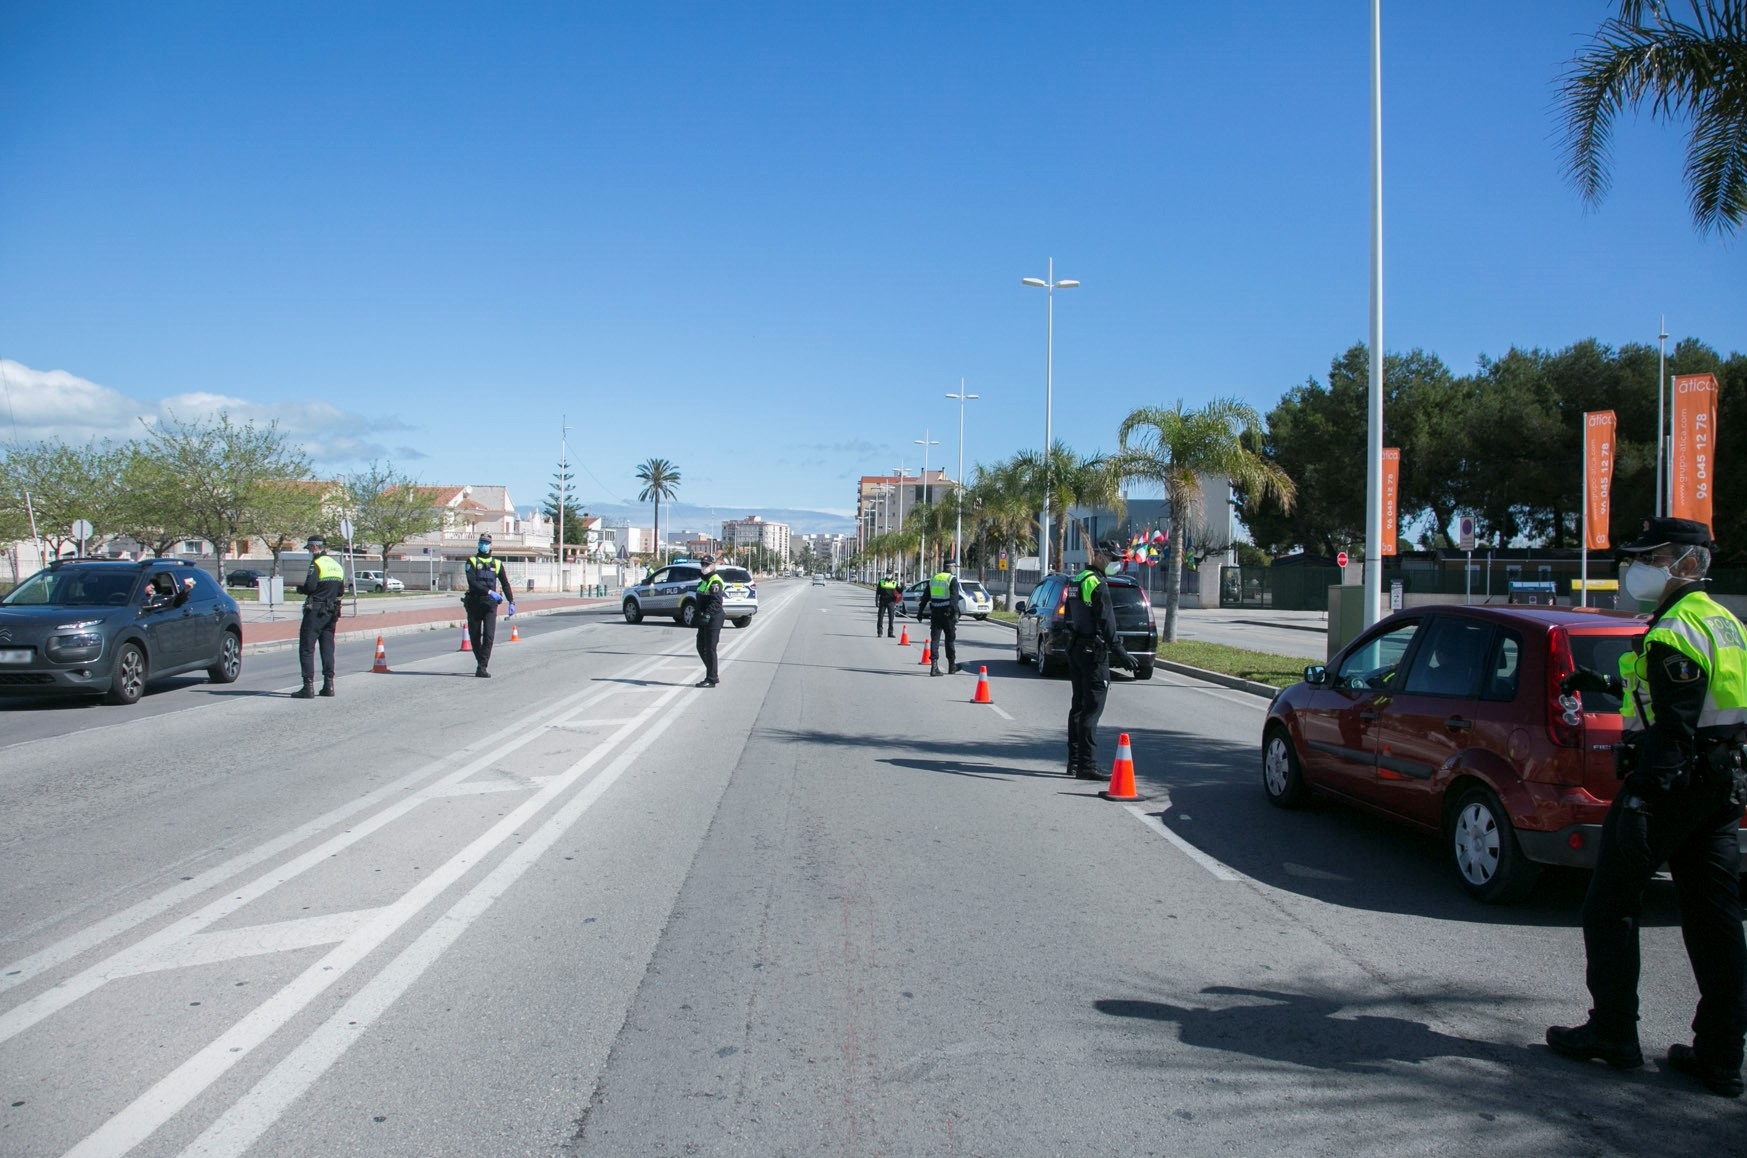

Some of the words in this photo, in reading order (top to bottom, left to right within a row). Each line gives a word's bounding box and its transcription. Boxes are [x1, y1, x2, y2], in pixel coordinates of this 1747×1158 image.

[1696, 413, 1707, 430] 78
[1601, 443, 1609, 457] 78
[1696, 433, 1707, 450] 12
[1601, 460, 1608, 473] 12
[1696, 454, 1707, 479] 045
[1600, 477, 1608, 498] 045
[1696, 482, 1707, 499] 96
